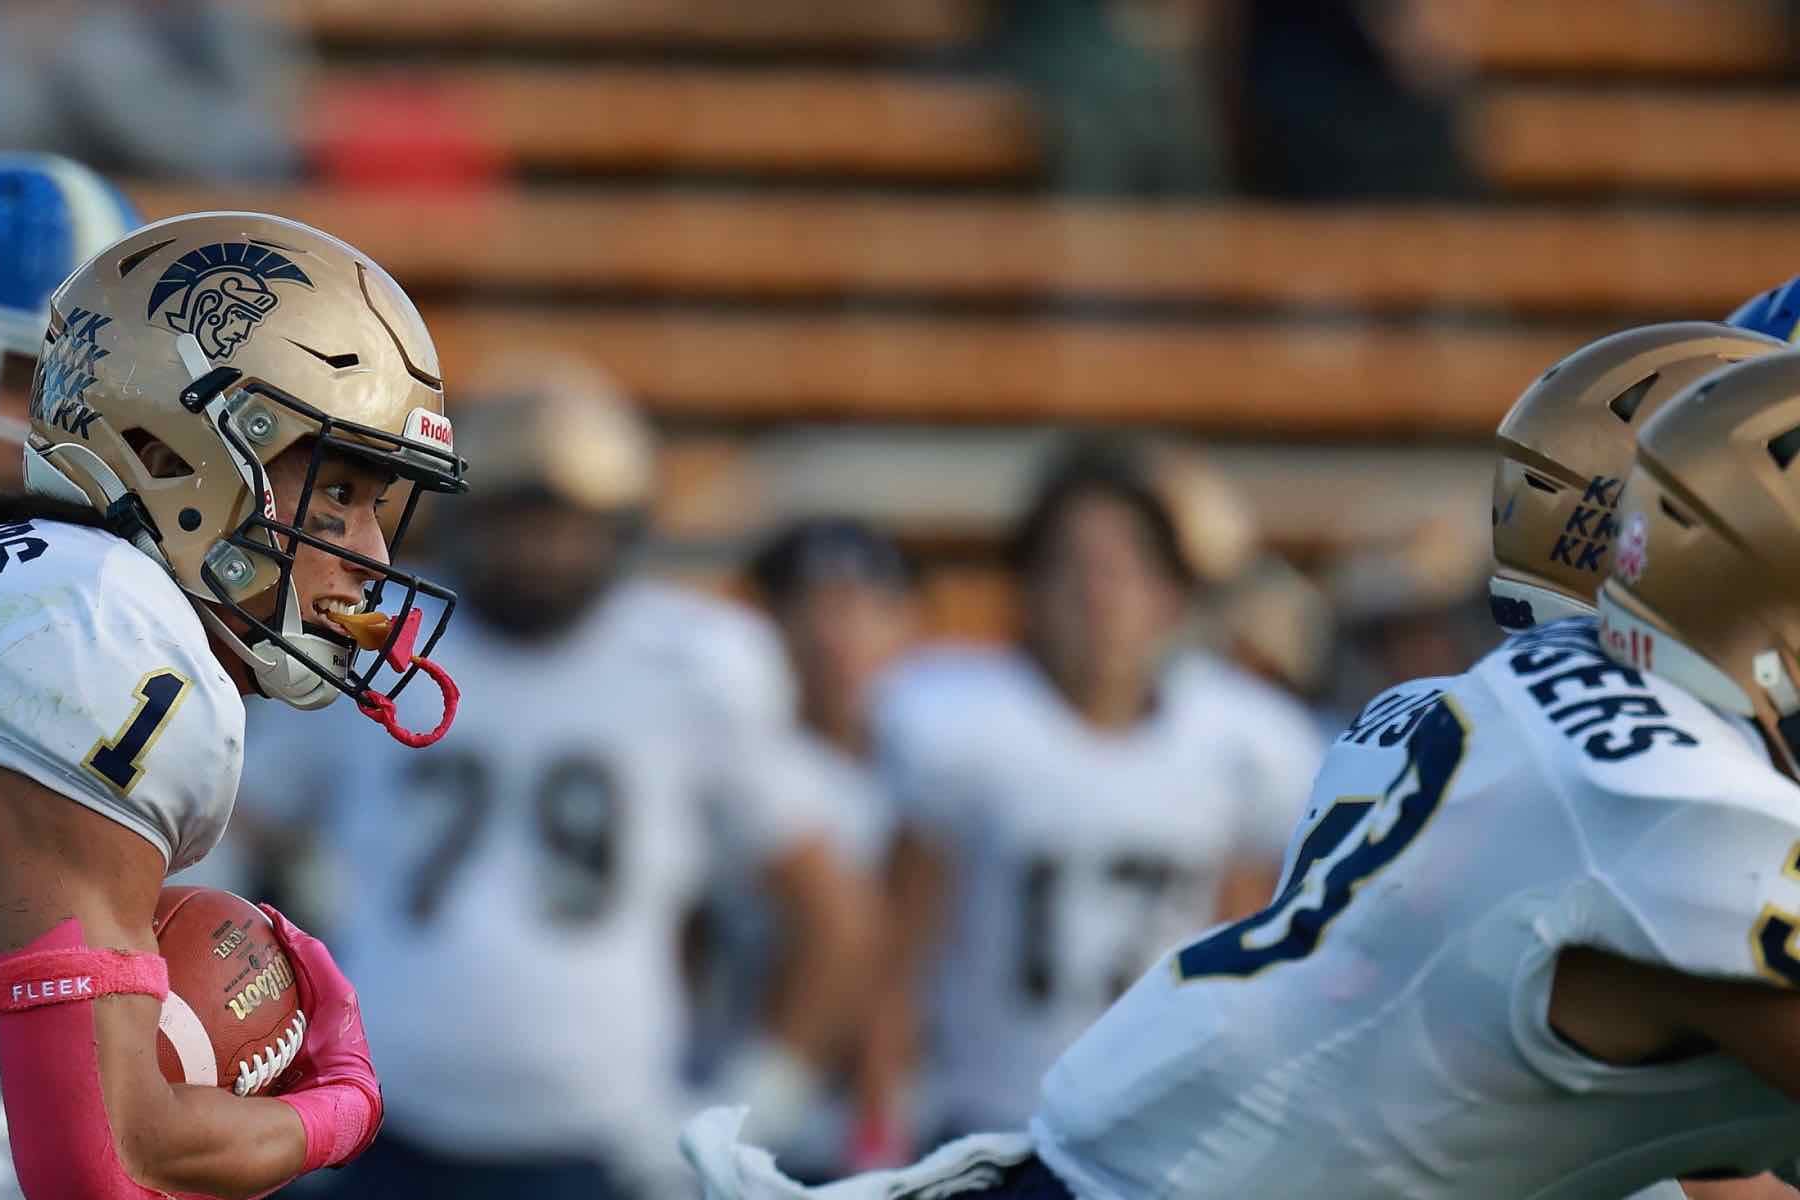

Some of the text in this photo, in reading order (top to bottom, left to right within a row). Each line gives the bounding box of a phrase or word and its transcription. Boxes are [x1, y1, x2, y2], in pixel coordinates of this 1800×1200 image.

[80, 667, 195, 797] 1
[398, 748, 625, 938] 79
[11, 976, 93, 1001] FLEEK
